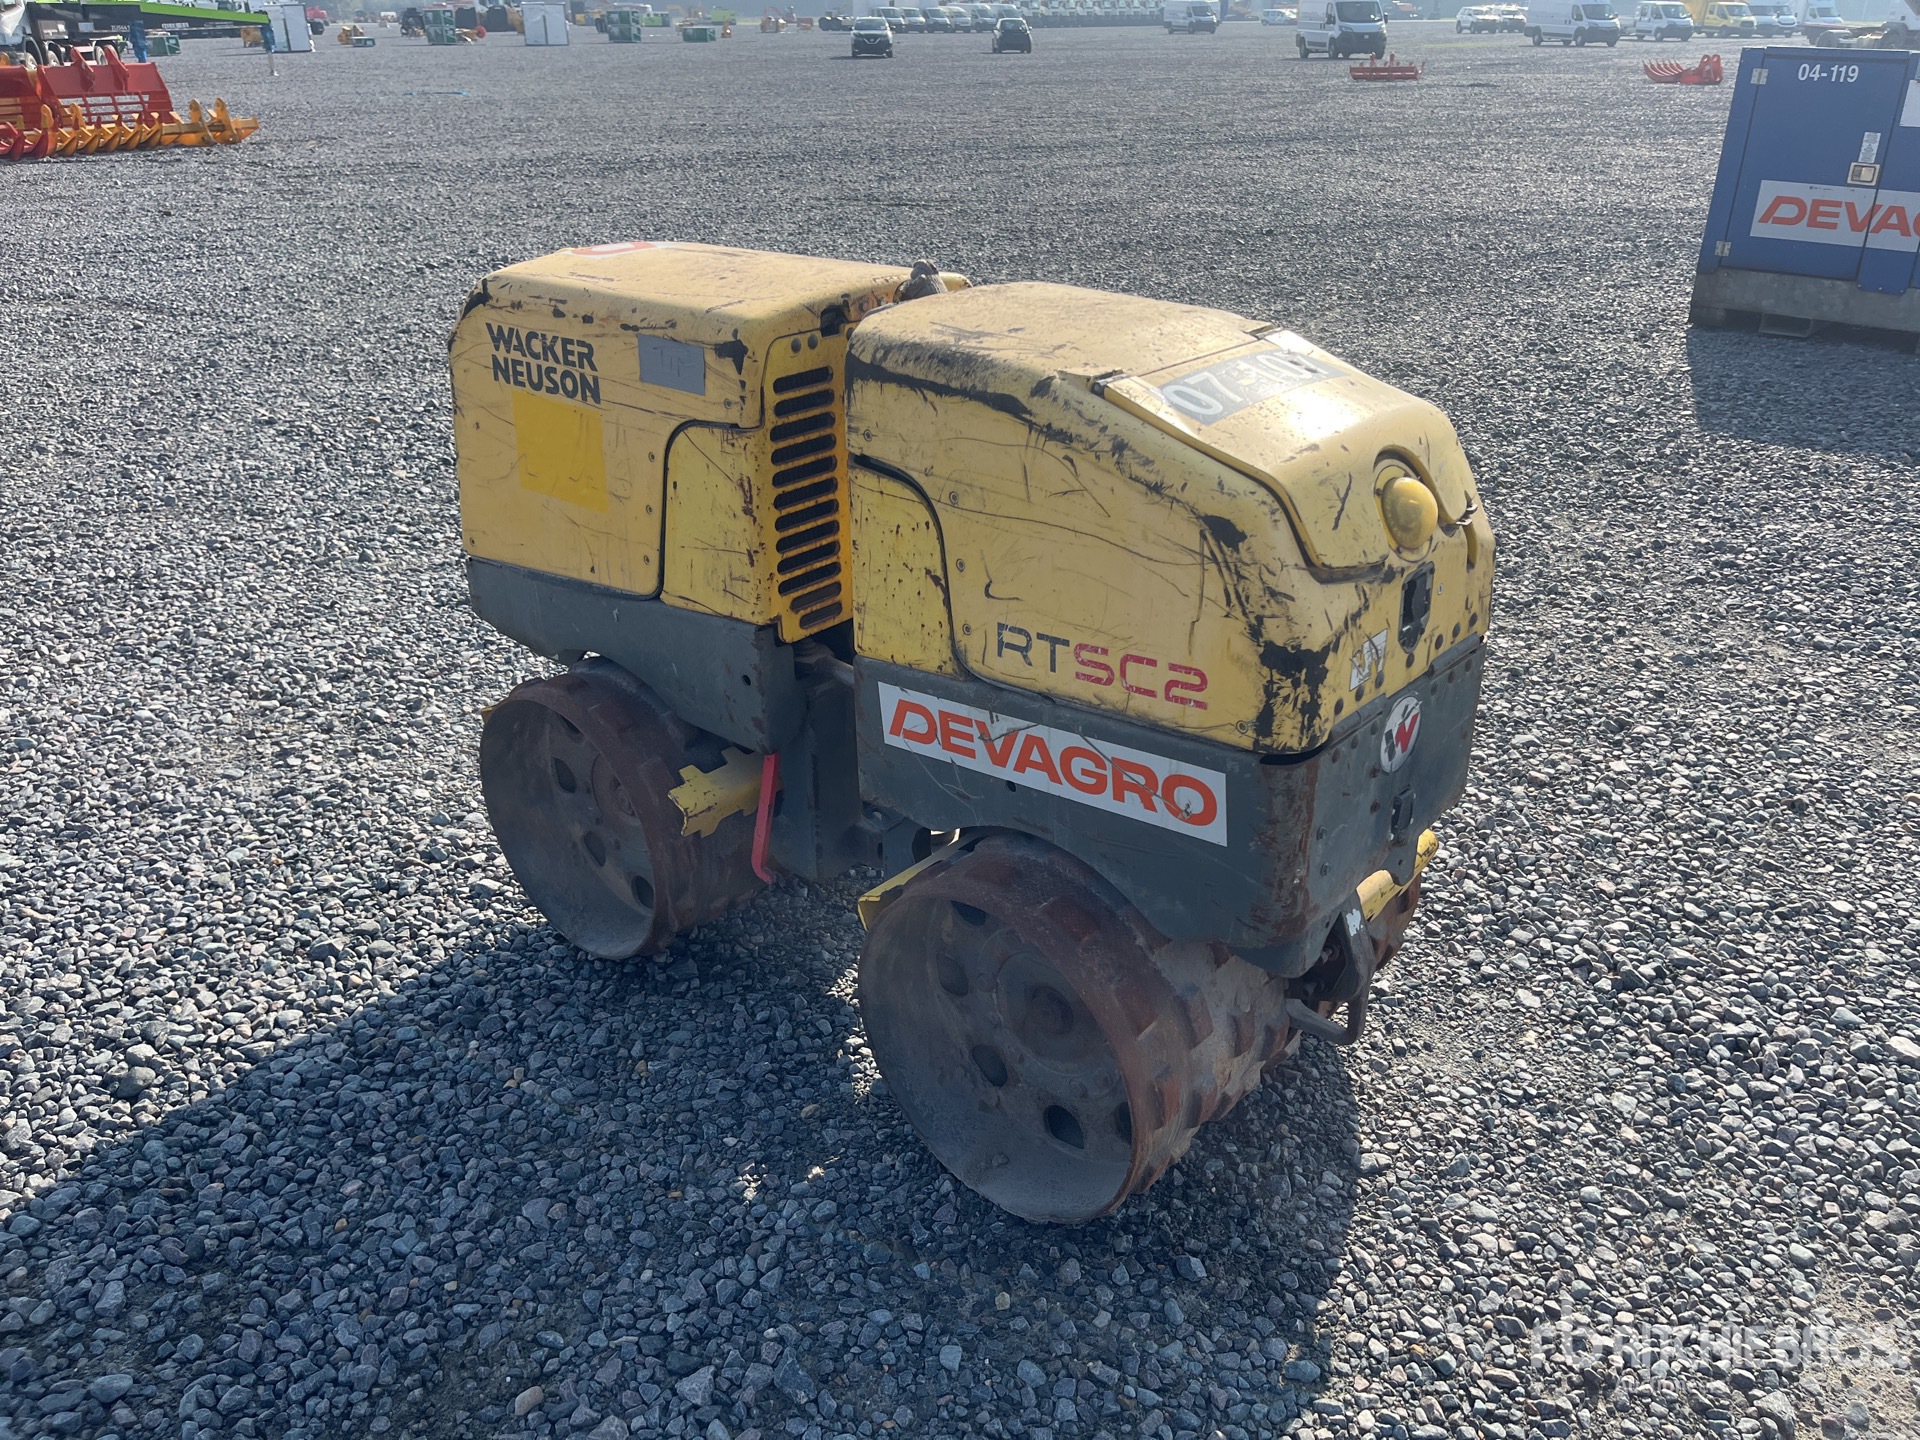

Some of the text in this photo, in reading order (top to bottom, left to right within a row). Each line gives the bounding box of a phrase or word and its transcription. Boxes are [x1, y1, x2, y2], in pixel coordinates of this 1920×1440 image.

[1798, 63, 1859, 83] 04-119
[1758, 195, 1920, 238] DEVA
[485, 322, 599, 373] WACKER
[491, 354, 601, 405] NEUSON
[889, 698, 1218, 827] DEVAGRO
